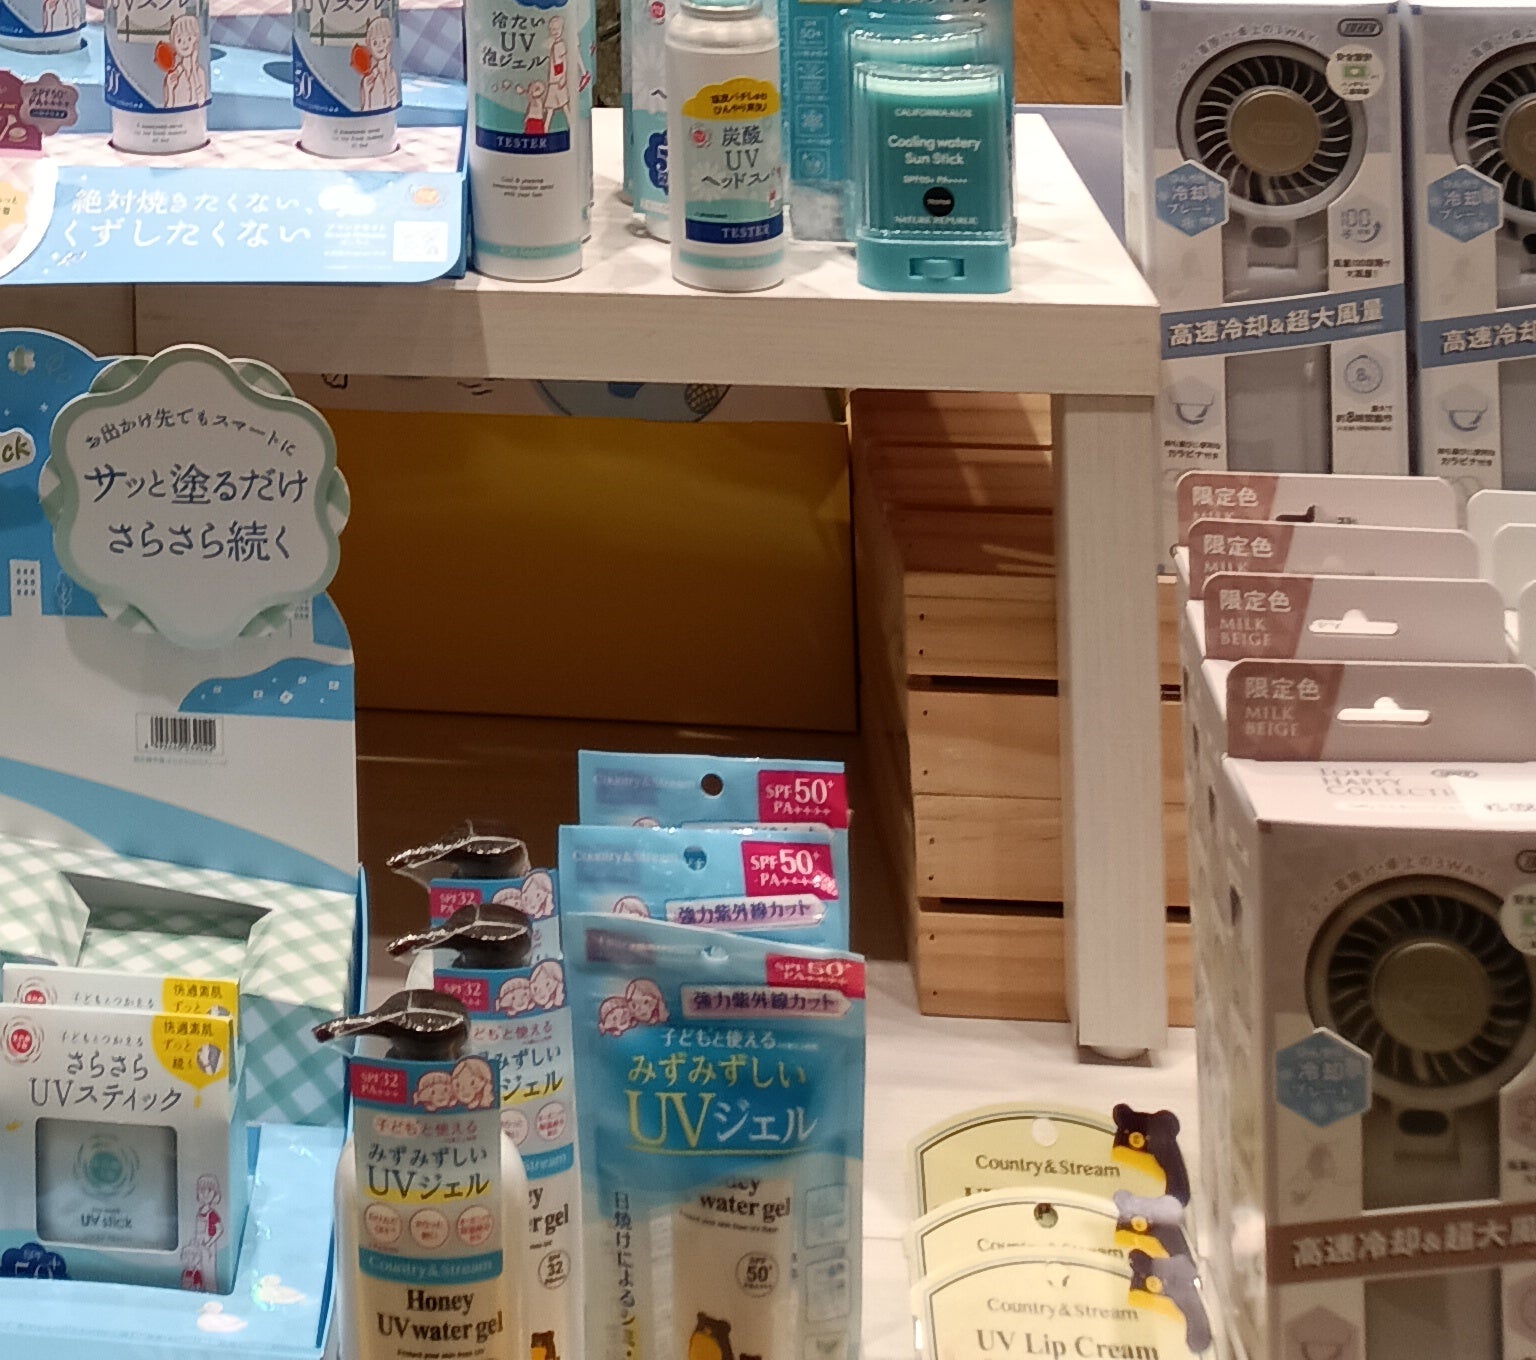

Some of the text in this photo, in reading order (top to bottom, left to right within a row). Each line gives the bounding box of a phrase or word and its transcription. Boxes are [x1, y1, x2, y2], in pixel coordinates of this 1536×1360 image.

[492, 11, 545, 30] 冷たい
[500, 31, 536, 53] UV
[482, 46, 550, 72] 泡ジェル
[496, 135, 548, 149] TESTER
[721, 126, 764, 147] 炭酸
[887, 135, 982, 151] Cooling watery
[724, 148, 760, 171] UV
[904, 151, 965, 165] Sun Stick
[72, 187, 315, 216] 絶対焼きたくない、
[62, 217, 313, 248] くずしたくない
[721, 225, 771, 238] TESTER
[1168, 297, 1384, 347] 高速冷却&超大風量
[83, 463, 310, 506] サッと塗るだけ
[1192, 486, 1259, 507] 限定色
[107, 522, 291, 563] さらさら続く
[1203, 535, 1273, 558] 限定色
[1219, 589, 1292, 613] 限定色
[1220, 617, 1266, 631] MILK
[1220, 631, 1272, 647] BEIGE
[1244, 676, 1321, 701] 限定色
[1244, 704, 1295, 721] MILK
[1244, 721, 1300, 738] BEIGE
[678, 901, 811, 926] 強力紫外線カット
[172, 982, 224, 999] 快適素肌
[692, 993, 835, 1011] 強力紫外線カット
[163, 1019, 214, 1038] 快適素肌
[663, 1029, 777, 1049] 子どもと使える
[65, 1050, 150, 1080] さらさら
[628, 1052, 807, 1088] みずみずしい
[29, 1077, 182, 1113] UVスティック
[375, 1117, 478, 1138] 子どもと使える
[623, 1087, 819, 1148] UVジェル
[367, 1142, 489, 1166] みずみずしい
[366, 1166, 491, 1199] UVジェル
[545, 1203, 569, 1237] gel
[700, 1193, 759, 1216] water
[762, 1196, 791, 1224] gel
[80, 1213, 133, 1230] UV stick
[547, 1260, 563, 1276] 32
[406, 1289, 475, 1316] Honey
[376, 1312, 504, 1342] UV water gel
[976, 1328, 1159, 1360] UV Lip Cream
